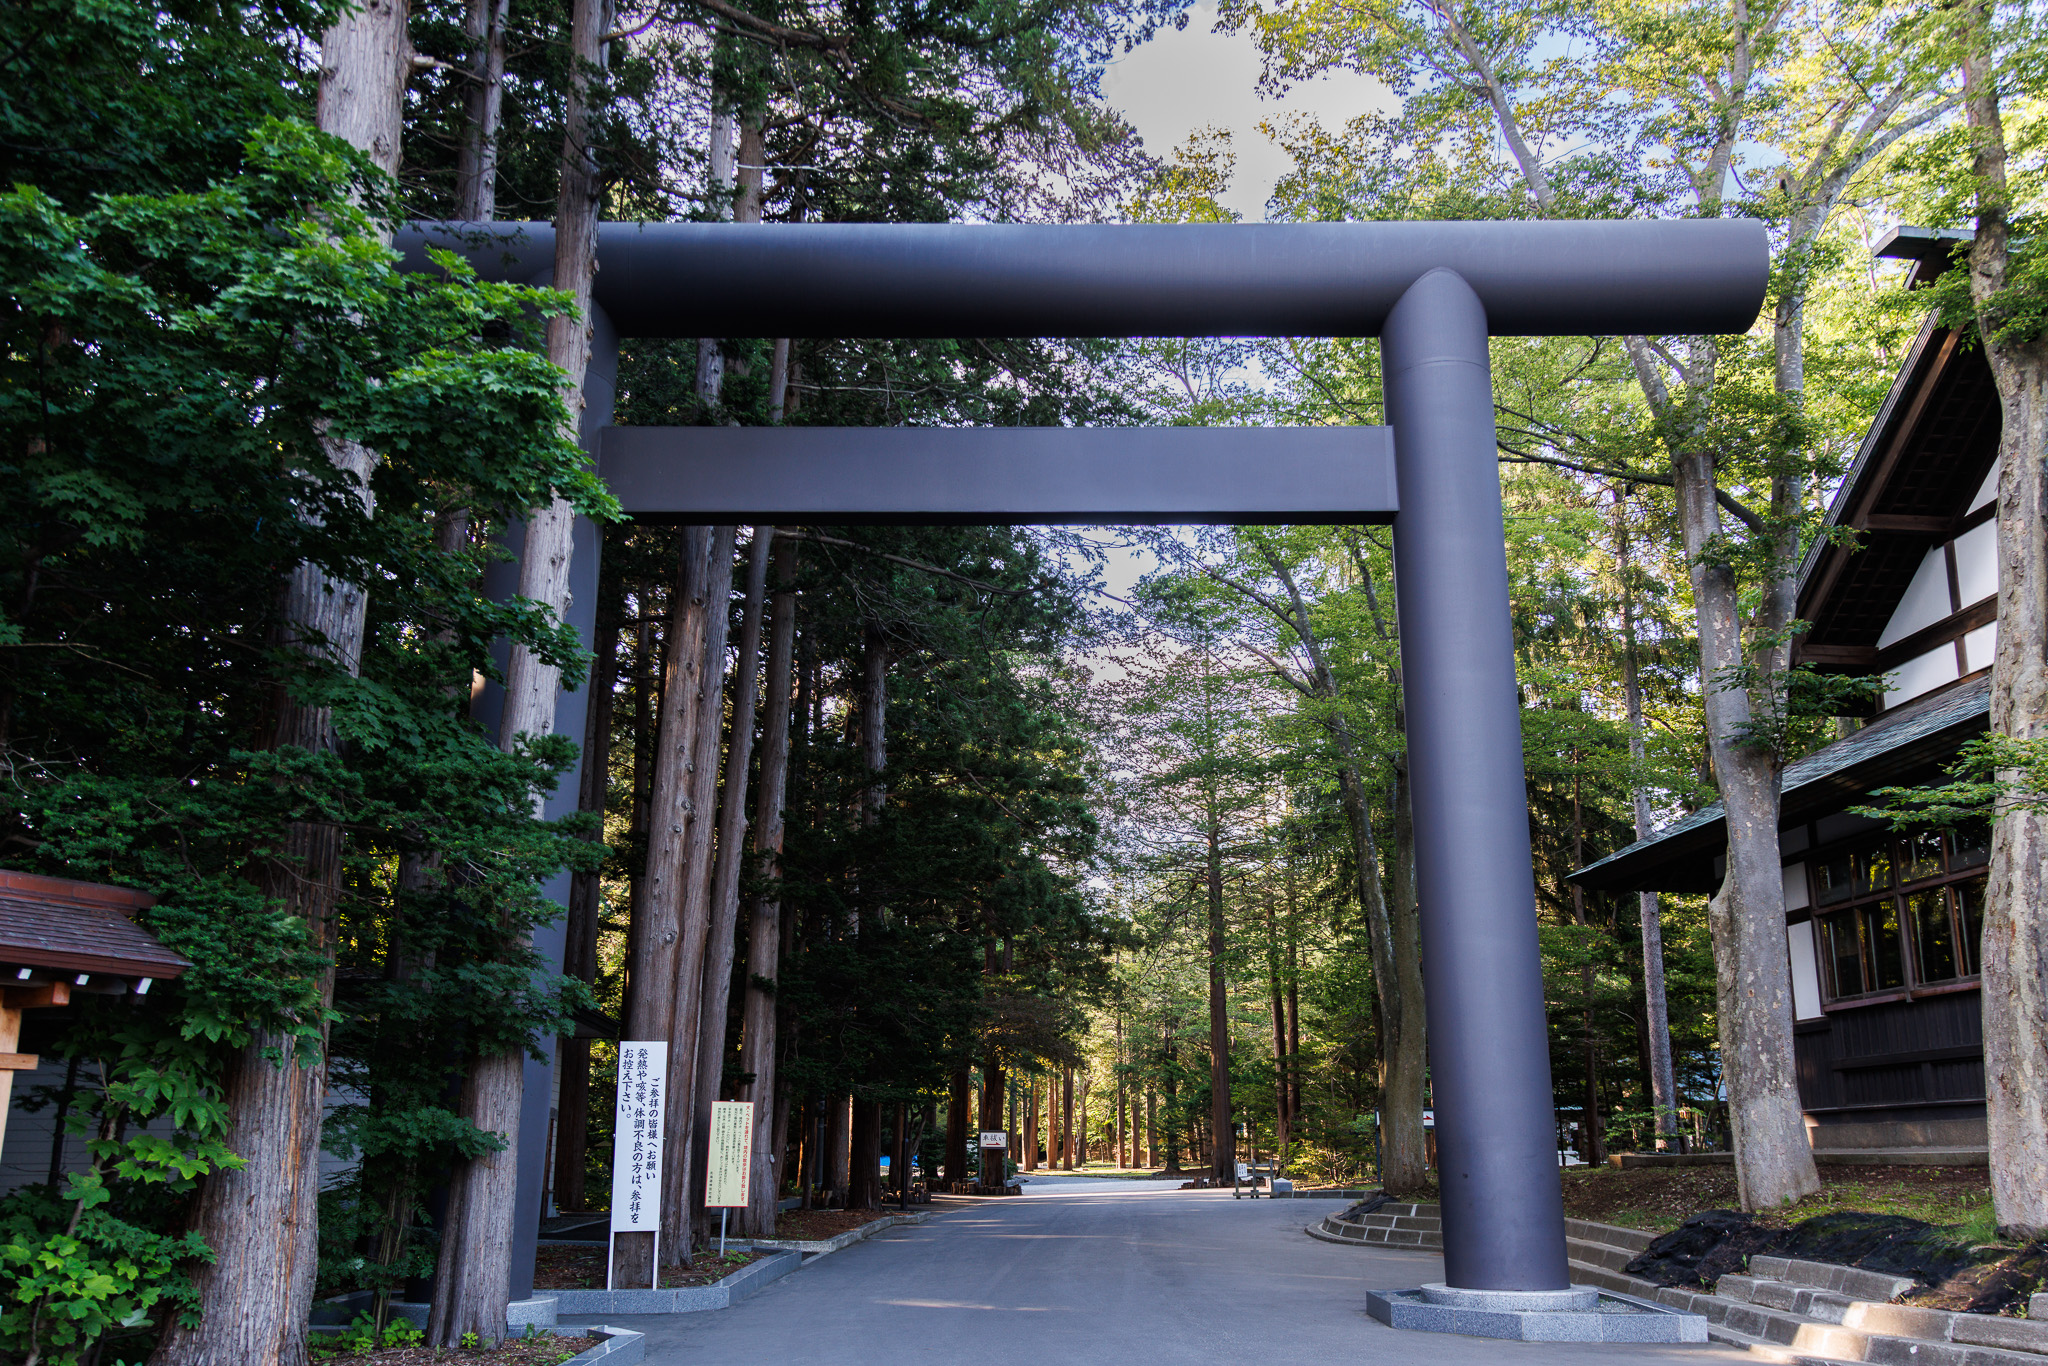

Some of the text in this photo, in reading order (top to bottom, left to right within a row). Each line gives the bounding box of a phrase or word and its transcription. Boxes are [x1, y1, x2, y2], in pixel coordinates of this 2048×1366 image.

[621, 1048, 634, 1118] お控え下さい。
[645, 1077, 660, 1180] ご参拝の皆様へお願い
[629, 1048, 648, 1224] 発熱や咳等、体調不良の方は、参拝を
